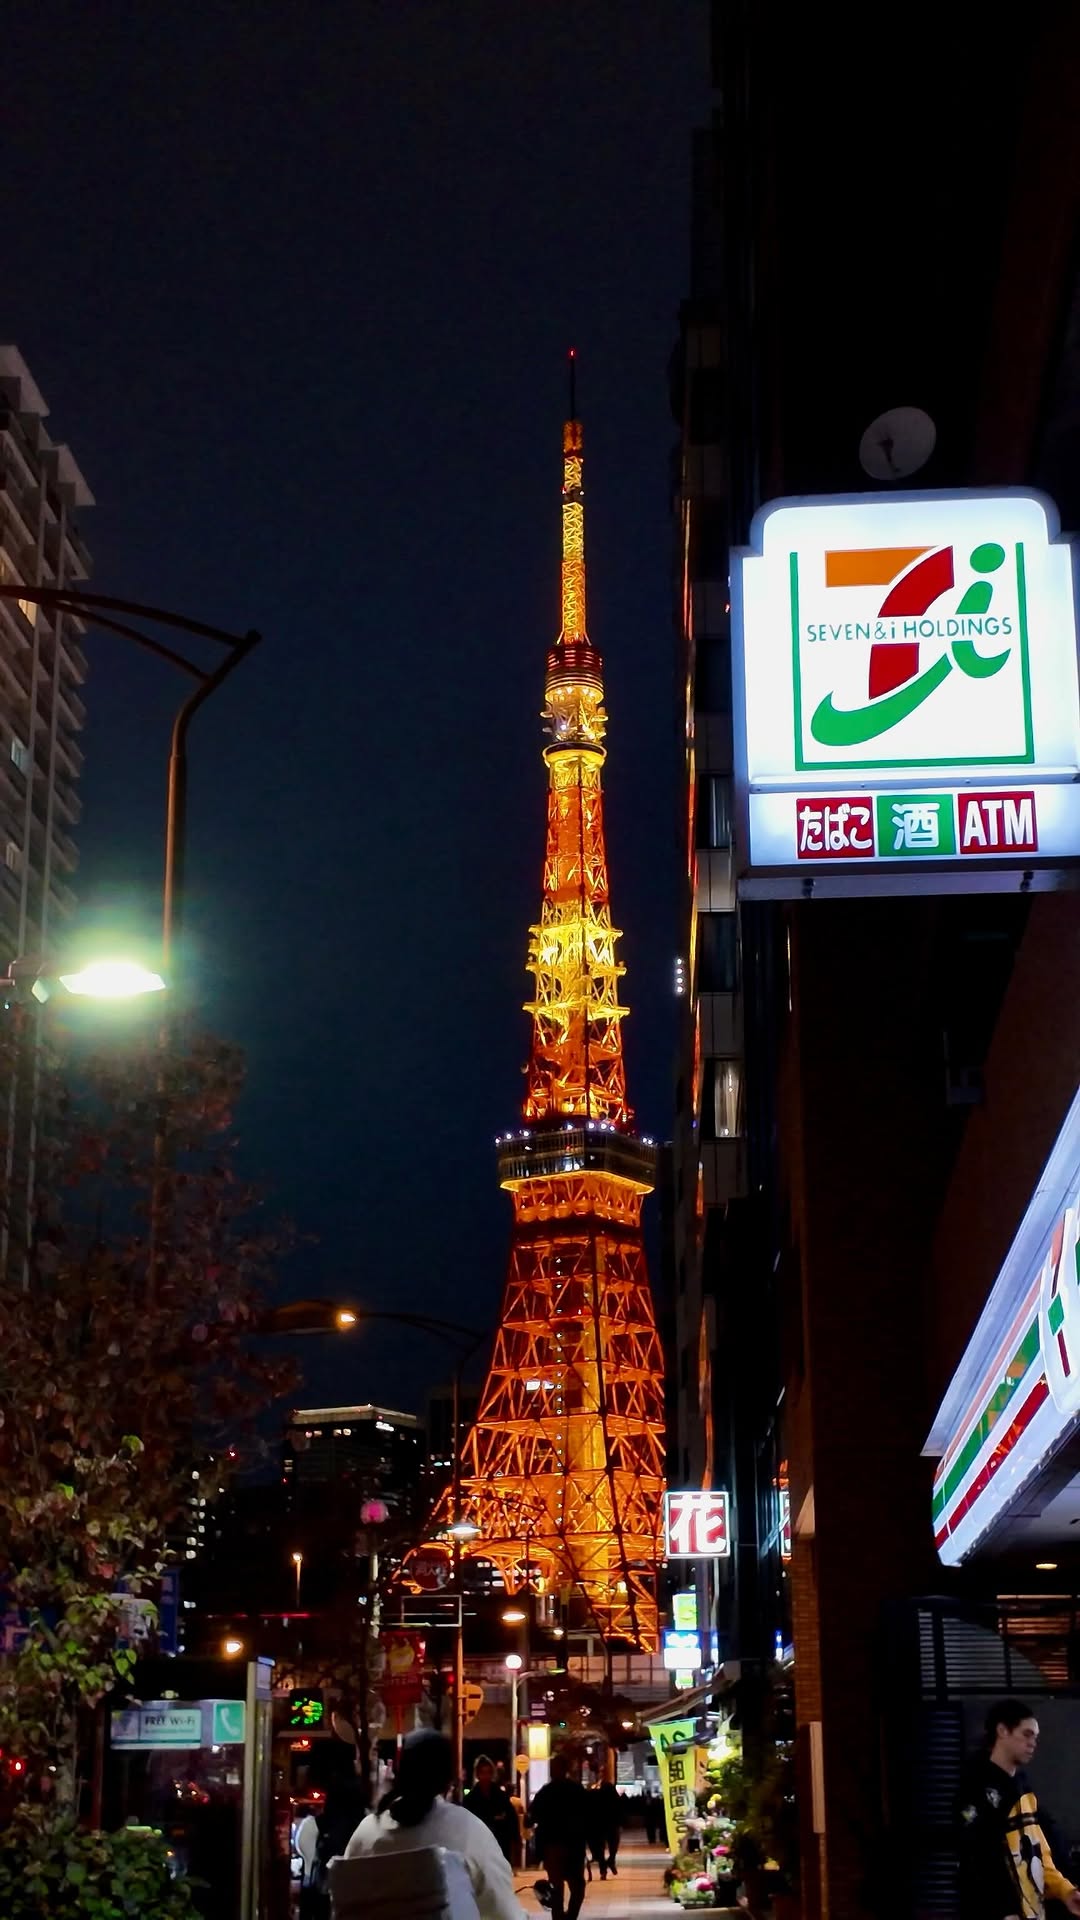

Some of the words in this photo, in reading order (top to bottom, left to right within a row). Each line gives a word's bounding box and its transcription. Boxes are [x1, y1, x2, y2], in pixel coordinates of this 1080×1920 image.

[903, 616, 1013, 638] HOLDINGS
[799, 803, 873, 852] たばこ
[891, 802, 941, 850] 酒
[963, 798, 1034, 847] ATM
[669, 1494, 727, 1553] 花
